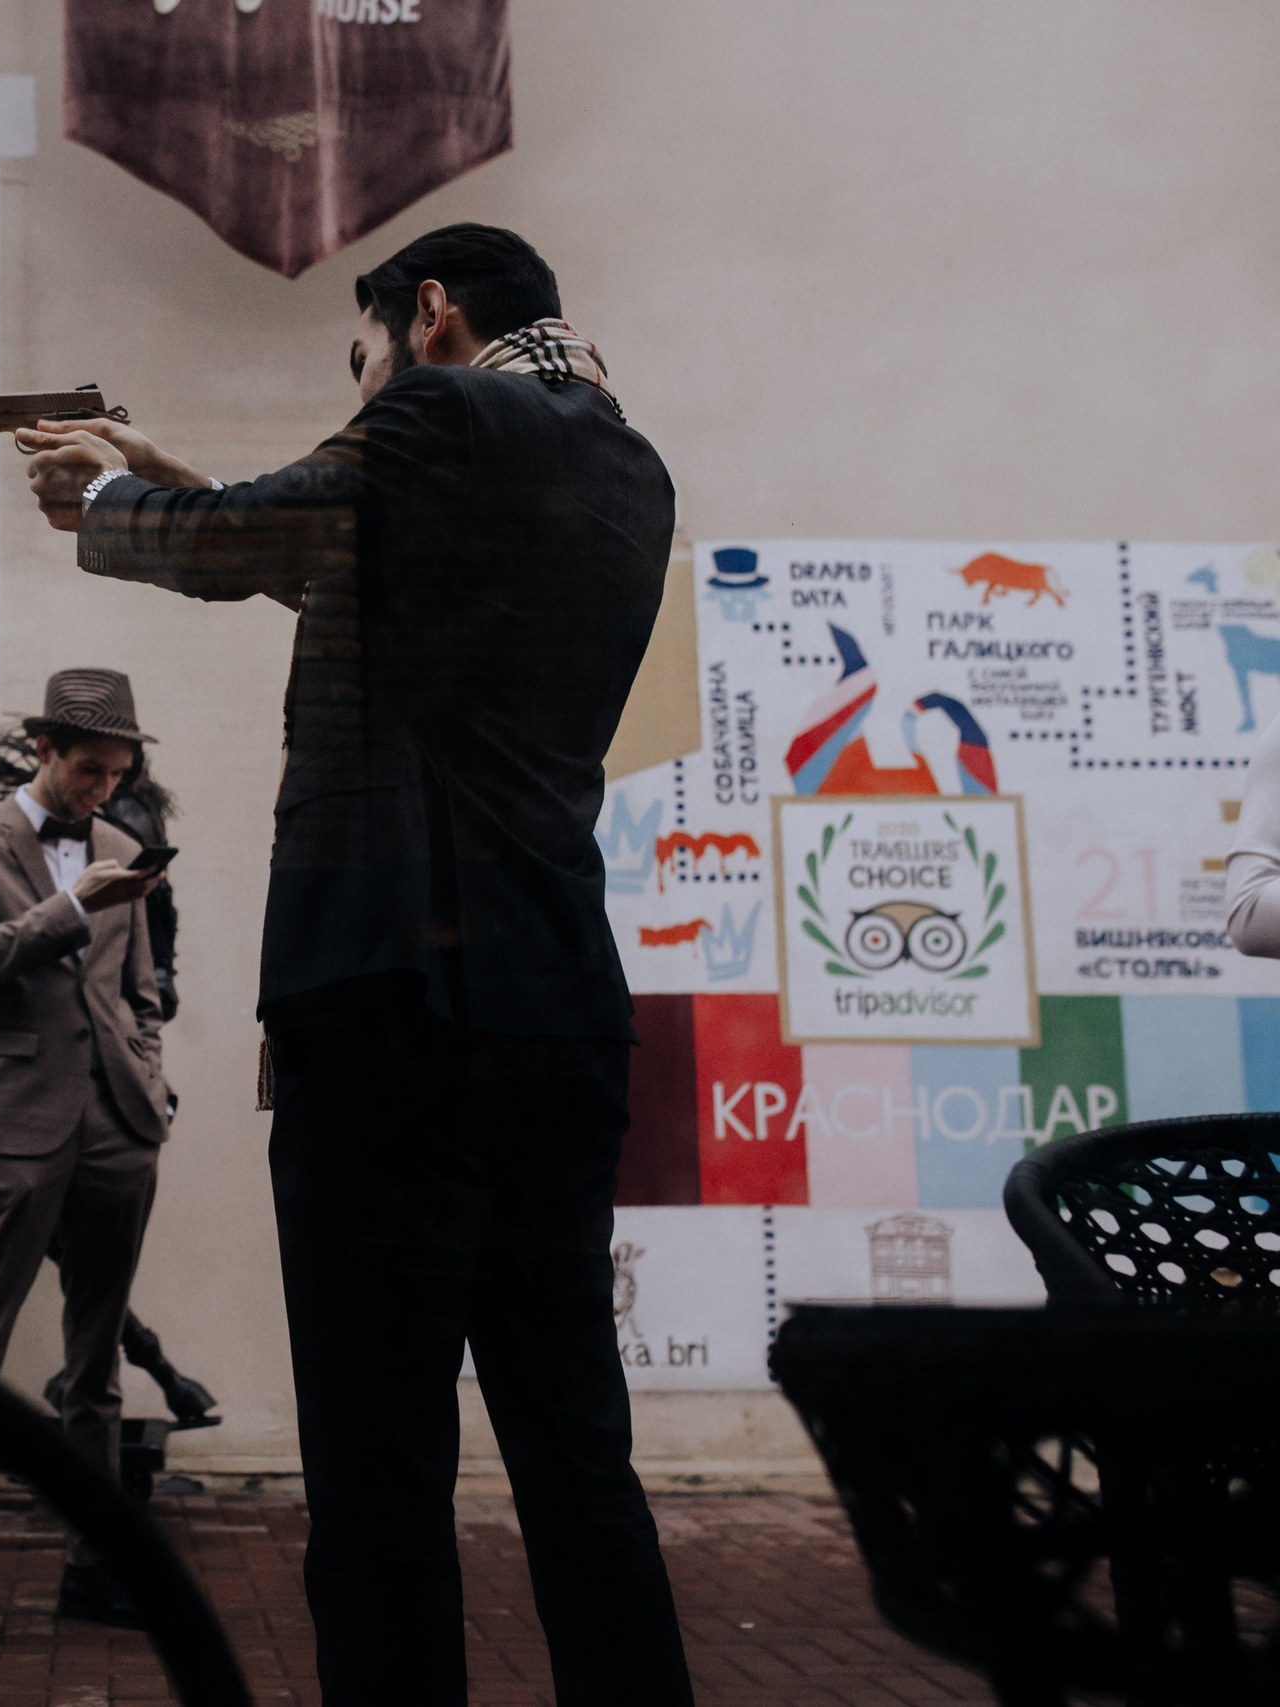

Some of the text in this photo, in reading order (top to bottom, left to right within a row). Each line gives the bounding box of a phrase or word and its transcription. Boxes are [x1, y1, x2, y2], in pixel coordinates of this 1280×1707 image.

[790, 562, 871, 581] DRAPED
[791, 589, 847, 608] DATA
[927, 611, 993, 631] ПАРК
[928, 640, 1074, 661] ГАЛИЦКОГО
[708, 661, 734, 805] СОБАЧКИНА
[735, 690, 759, 805] СТОЛИЦА
[848, 864, 953, 889] CHOICE
[1075, 847, 1159, 920] 21
[835, 986, 977, 1018] tripadvisor
[712, 1081, 1119, 1147] КРАСНОДАР
